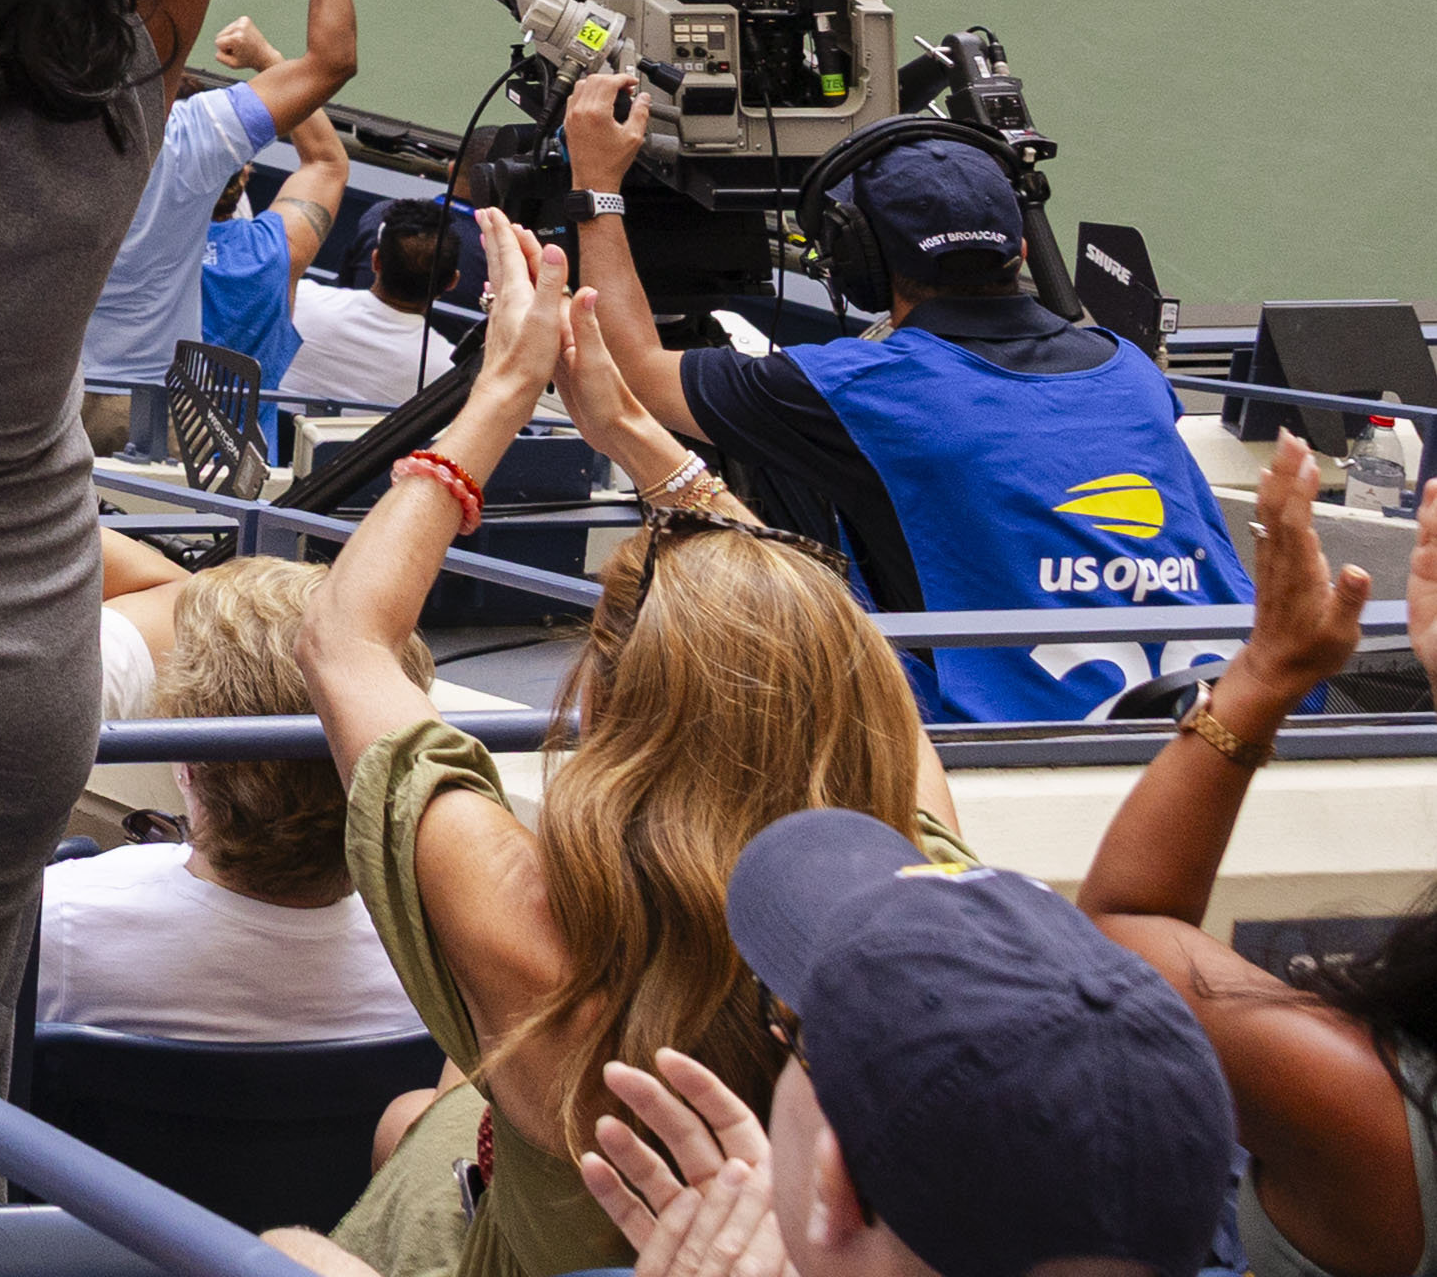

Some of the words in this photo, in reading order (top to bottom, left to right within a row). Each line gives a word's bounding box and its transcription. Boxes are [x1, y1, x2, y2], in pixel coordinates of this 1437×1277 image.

[919, 234, 946, 252] HOST
[947, 230, 1007, 244] BROADCAST
[1085, 243, 1133, 286] SHURE
[1039, 556, 1099, 592] us
[1103, 556, 1198, 602] open
